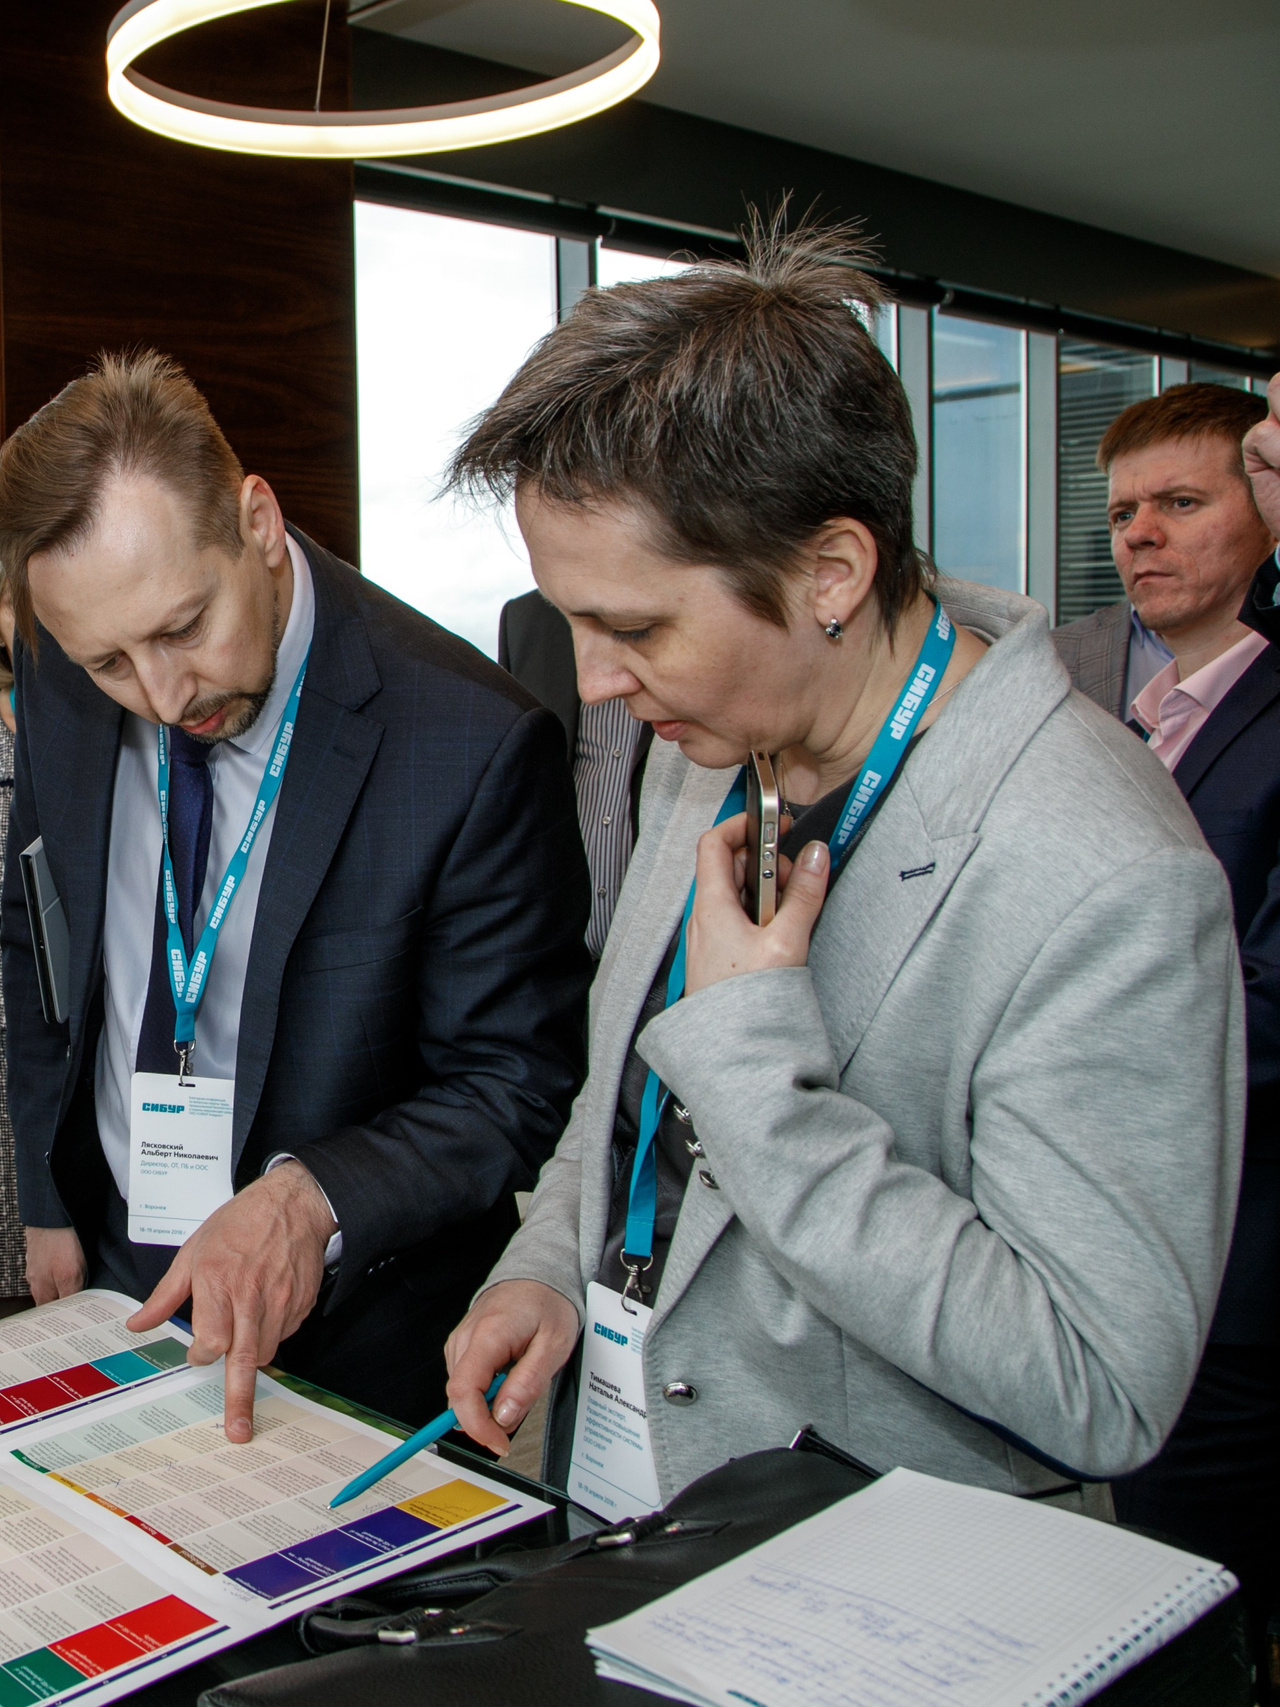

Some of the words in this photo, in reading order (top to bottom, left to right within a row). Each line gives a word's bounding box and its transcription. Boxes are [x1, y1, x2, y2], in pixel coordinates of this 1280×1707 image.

[890, 663, 936, 740] СИБУР
[269, 721, 294, 778] СИБУР
[240, 800, 266, 854] СИБУР
[837, 770, 882, 845] СИБУР
[165, 869, 177, 924] СИБУР
[210, 874, 236, 930] СИБУР
[185, 950, 206, 1004] СИБУР
[142, 1102, 185, 1114] СИБУР
[140, 1141, 183, 1150] Лясковский
[140, 1148, 171, 1158] Альберт
[173, 1151, 218, 1160] Николаевич
[140, 1160, 169, 1168] Директор,
[594, 1322, 628, 1346] СИБУР
[587, 1381, 615, 1400] Наталья
[588, 1371, 623, 1394] Тимашева
